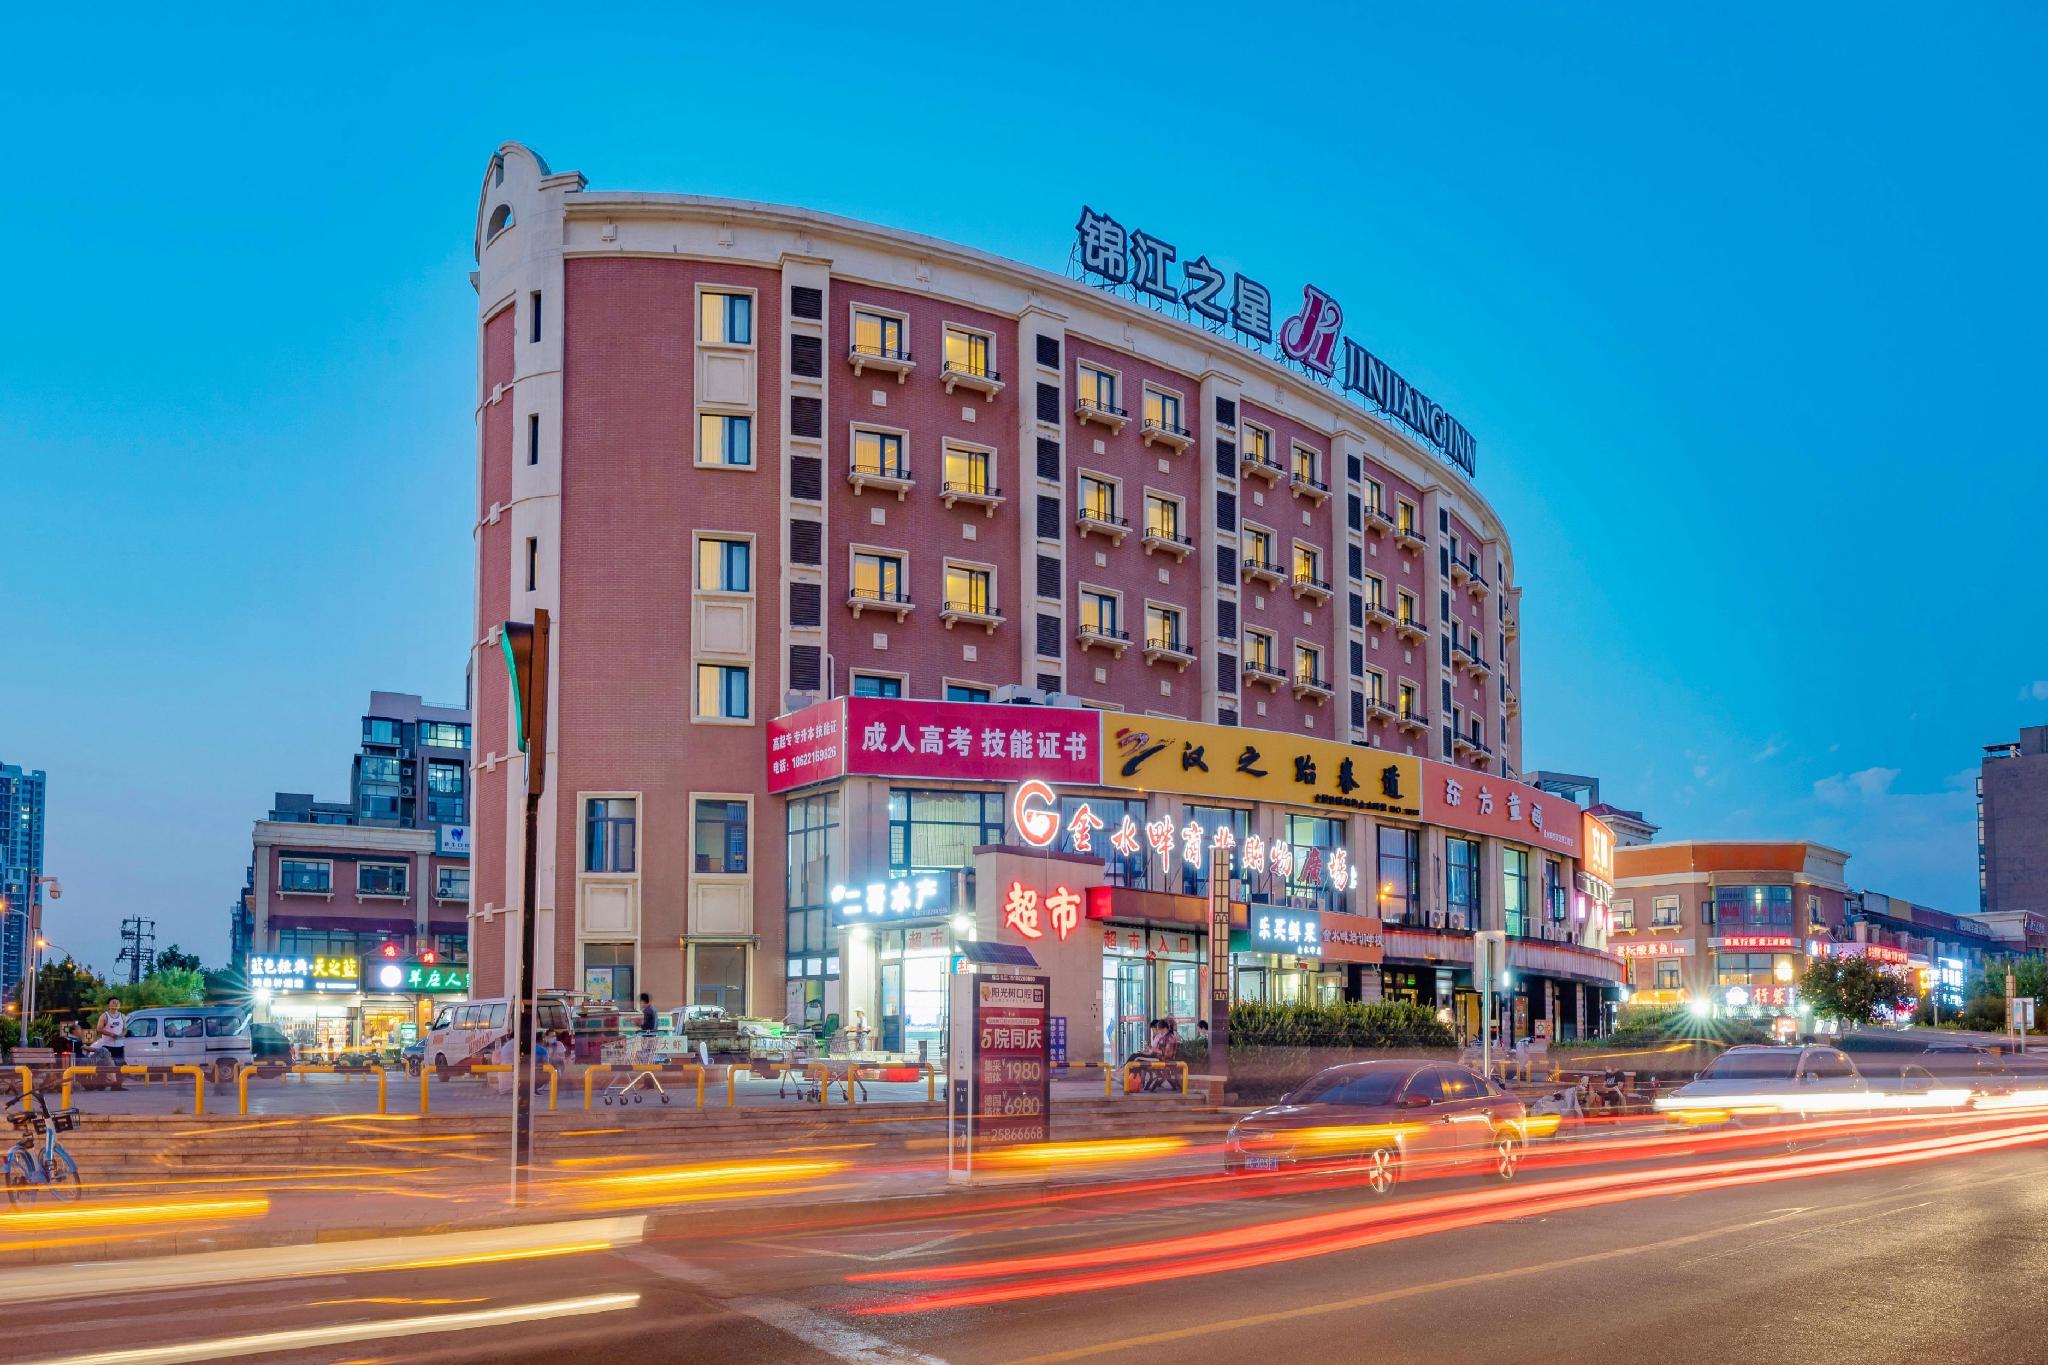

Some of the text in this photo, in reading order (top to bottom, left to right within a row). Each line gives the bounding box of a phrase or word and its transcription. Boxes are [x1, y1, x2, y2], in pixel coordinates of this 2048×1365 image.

[1075, 205, 1272, 344] 锦江之星
[1343, 337, 1477, 478] JINJIANG INN
[1005, 881, 1081, 941] 超市
[909, 929, 944, 950] 超市
[1103, 929, 1190, 955] 超市入口
[981, 1028, 1042, 1049] 5院同庆
